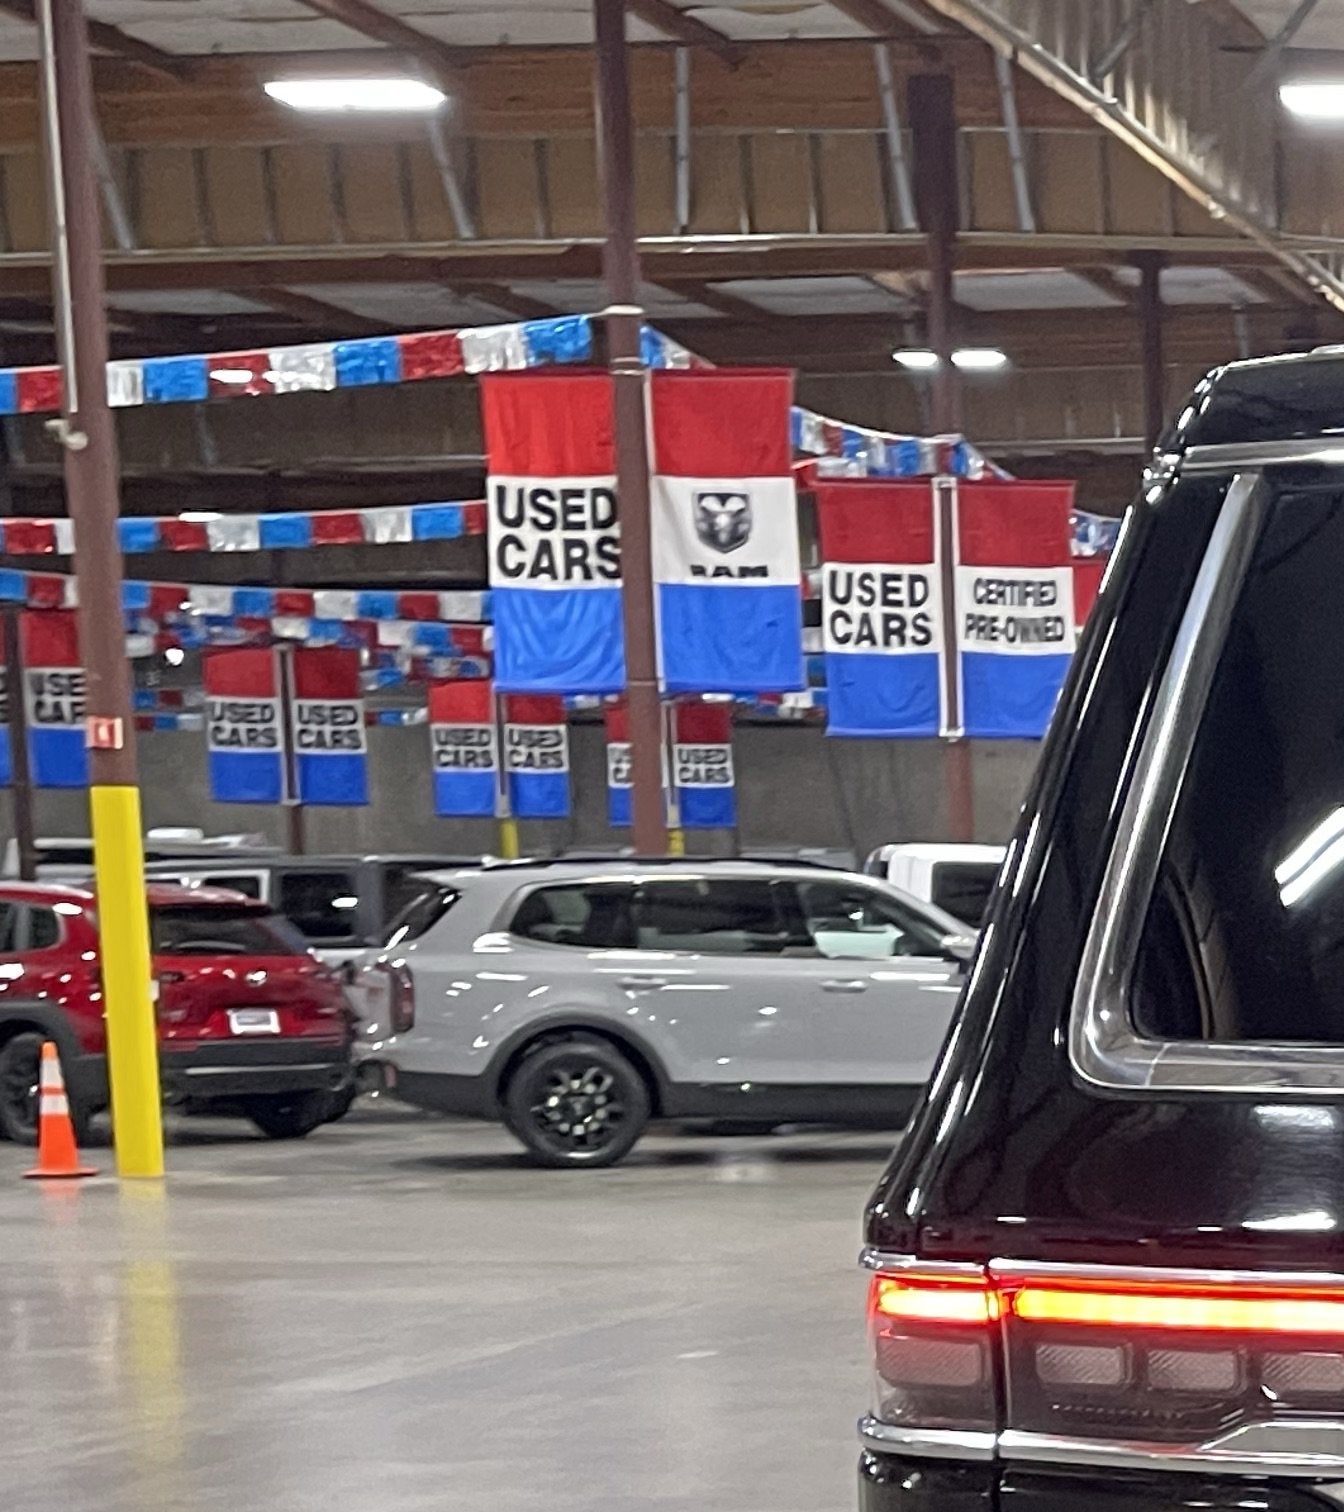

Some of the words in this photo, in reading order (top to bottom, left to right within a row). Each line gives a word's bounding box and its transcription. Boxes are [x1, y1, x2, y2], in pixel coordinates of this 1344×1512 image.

[496, 485, 618, 531] USED
[497, 534, 621, 580] CARS
[830, 570, 928, 608] USED
[973, 577, 1057, 607] CERTIFIED
[830, 610, 932, 647] CARS
[964, 613, 1065, 643] PRE-OWNED
[211, 701, 275, 724] USED
[298, 704, 359, 726] USED
[210, 725, 278, 748] CARS
[298, 728, 362, 750] CARS
[434, 727, 492, 748] USED
[508, 728, 563, 749] USED
[436, 748, 494, 768] CARS
[508, 749, 564, 769] CARS
